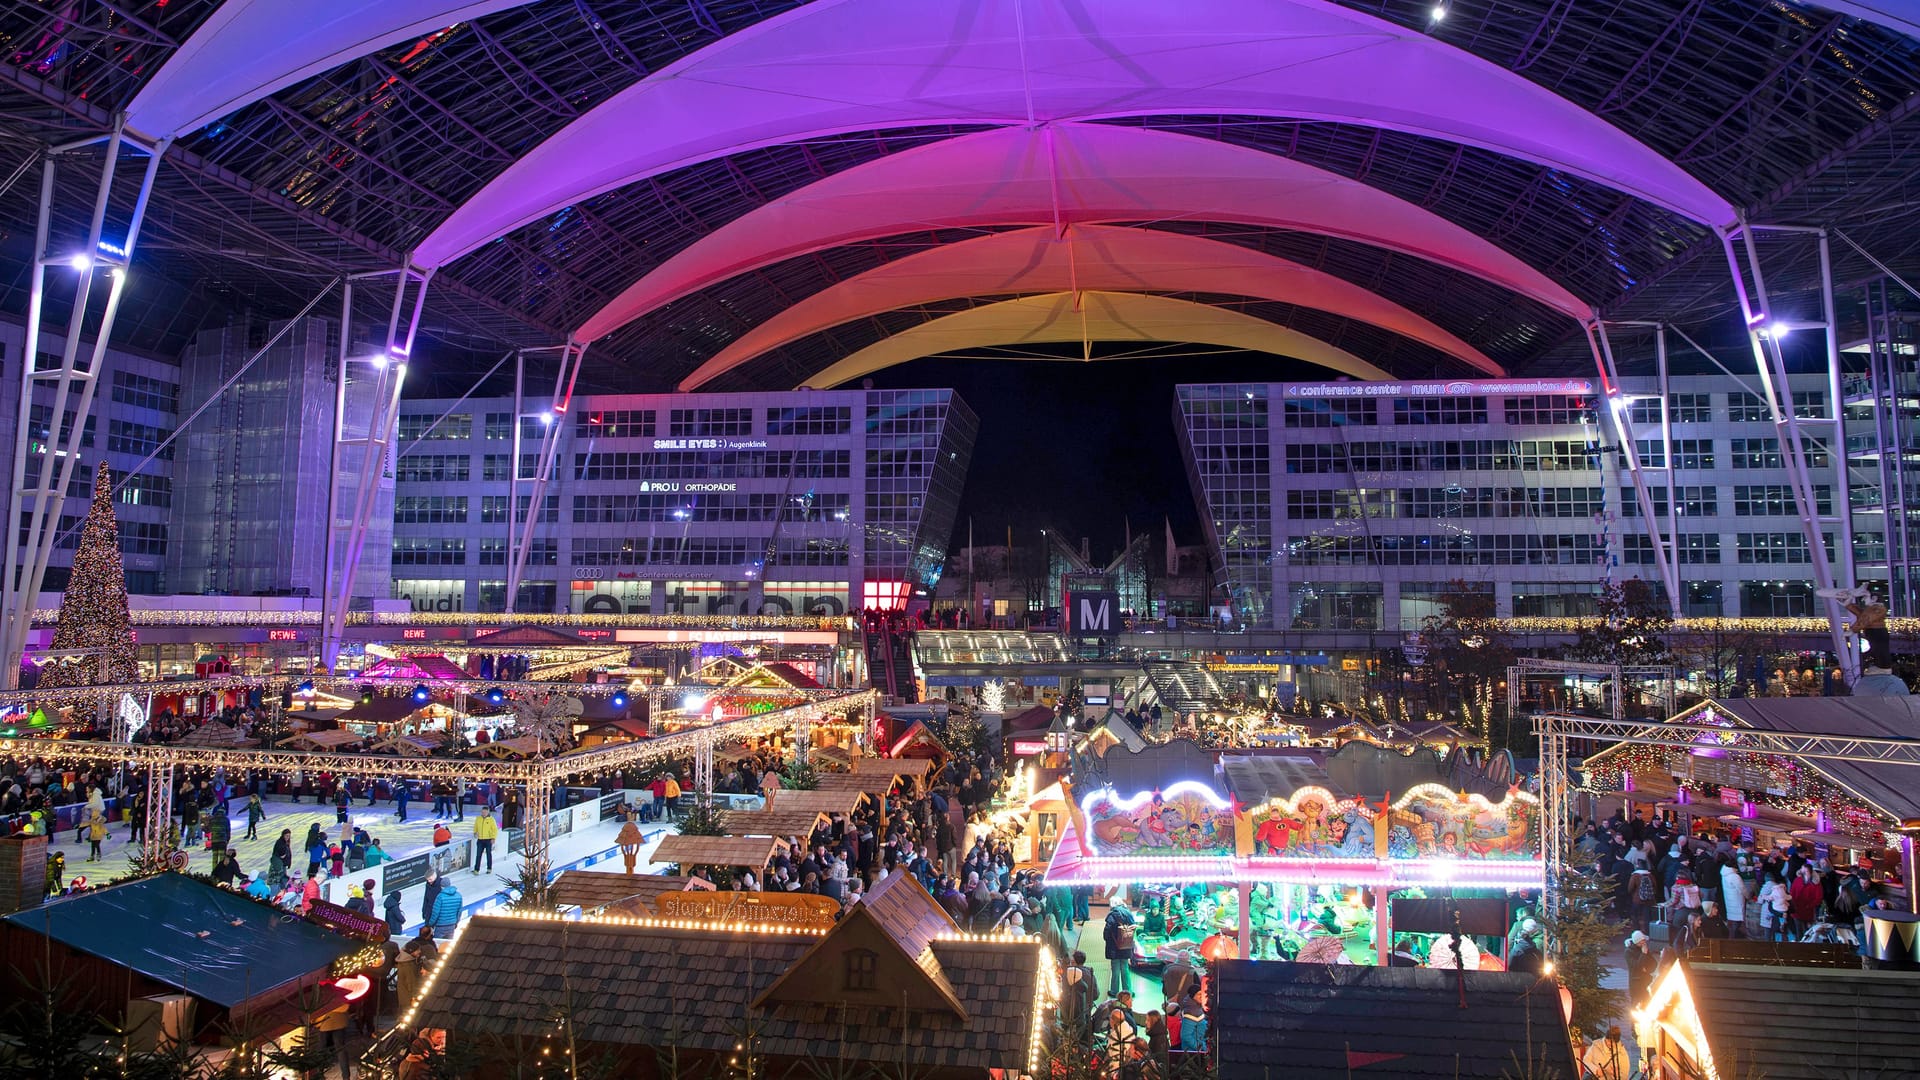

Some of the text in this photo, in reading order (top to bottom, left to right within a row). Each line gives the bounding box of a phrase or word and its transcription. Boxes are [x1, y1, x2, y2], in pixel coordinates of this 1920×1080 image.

[1300, 384, 1402, 396] conference center
[1480, 381, 1580, 393] www.municon.de
[653, 440, 687, 449] SMILE
[688, 440, 717, 449] EYES
[729, 441, 767, 450] Augenklinik
[651, 482, 737, 492] PRO U ORTHOPÄDIE
[617, 571, 713, 579] Audi Conference Center
[1080, 599, 1109, 630] M
[270, 630, 297, 641] REWE
[403, 629, 426, 639] REWE
[476, 629, 500, 638] RE
